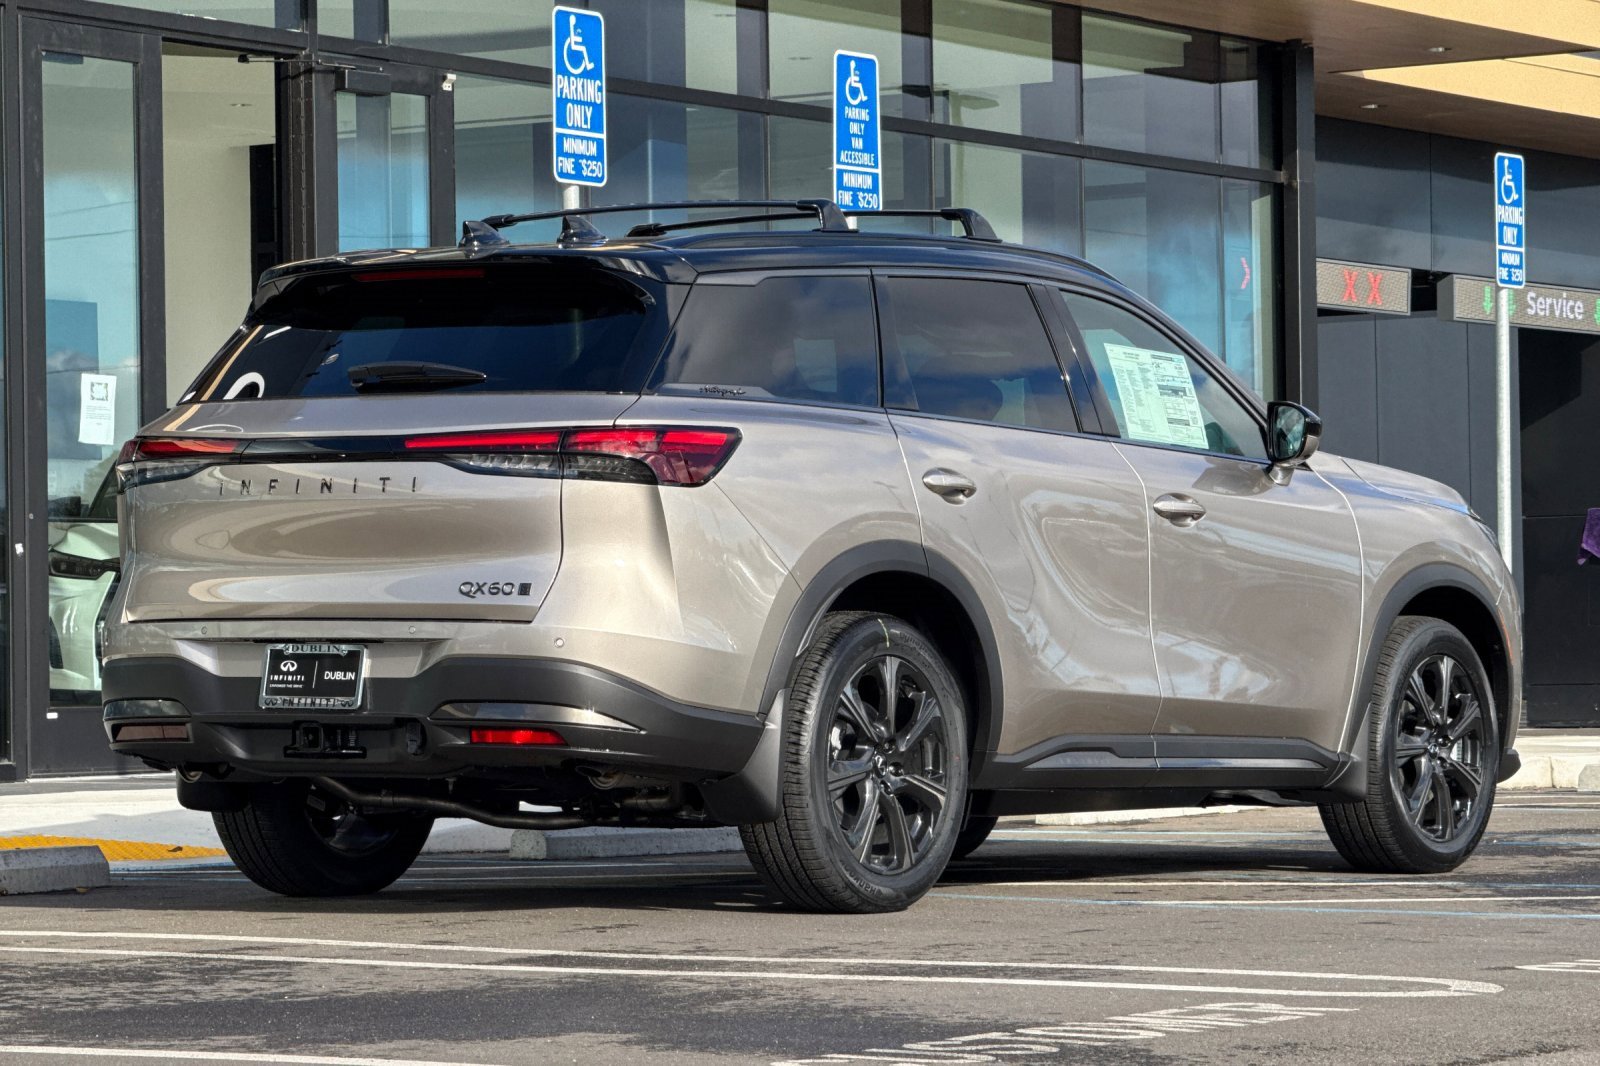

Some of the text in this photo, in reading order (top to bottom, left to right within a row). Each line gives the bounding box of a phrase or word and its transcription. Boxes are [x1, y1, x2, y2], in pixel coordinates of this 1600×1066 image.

[557, 74, 602, 105] PARKING
[566, 102, 593, 129] ONLY
[844, 106, 870, 122] PARKING
[849, 121, 865, 135] ONLY
[563, 136, 597, 157] MINIMUM
[851, 137, 863, 150] VAN
[840, 149, 875, 166] ACCESSIBLE
[558, 156, 603, 178] FINE $250
[843, 172, 873, 190] MINIMUM
[838, 190, 878, 208] FINE $250
[1498, 204, 1523, 226] PARKING
[1503, 225, 1518, 246] ONLY
[1527, 291, 1584, 320] Service
[218, 476, 417, 496] INFINITI
[459, 581, 515, 599] QX60
[291, 644, 340, 653] DUBLIN
[270, 674, 305, 682] INFINITI
[324, 671, 356, 681] DUBLIN
